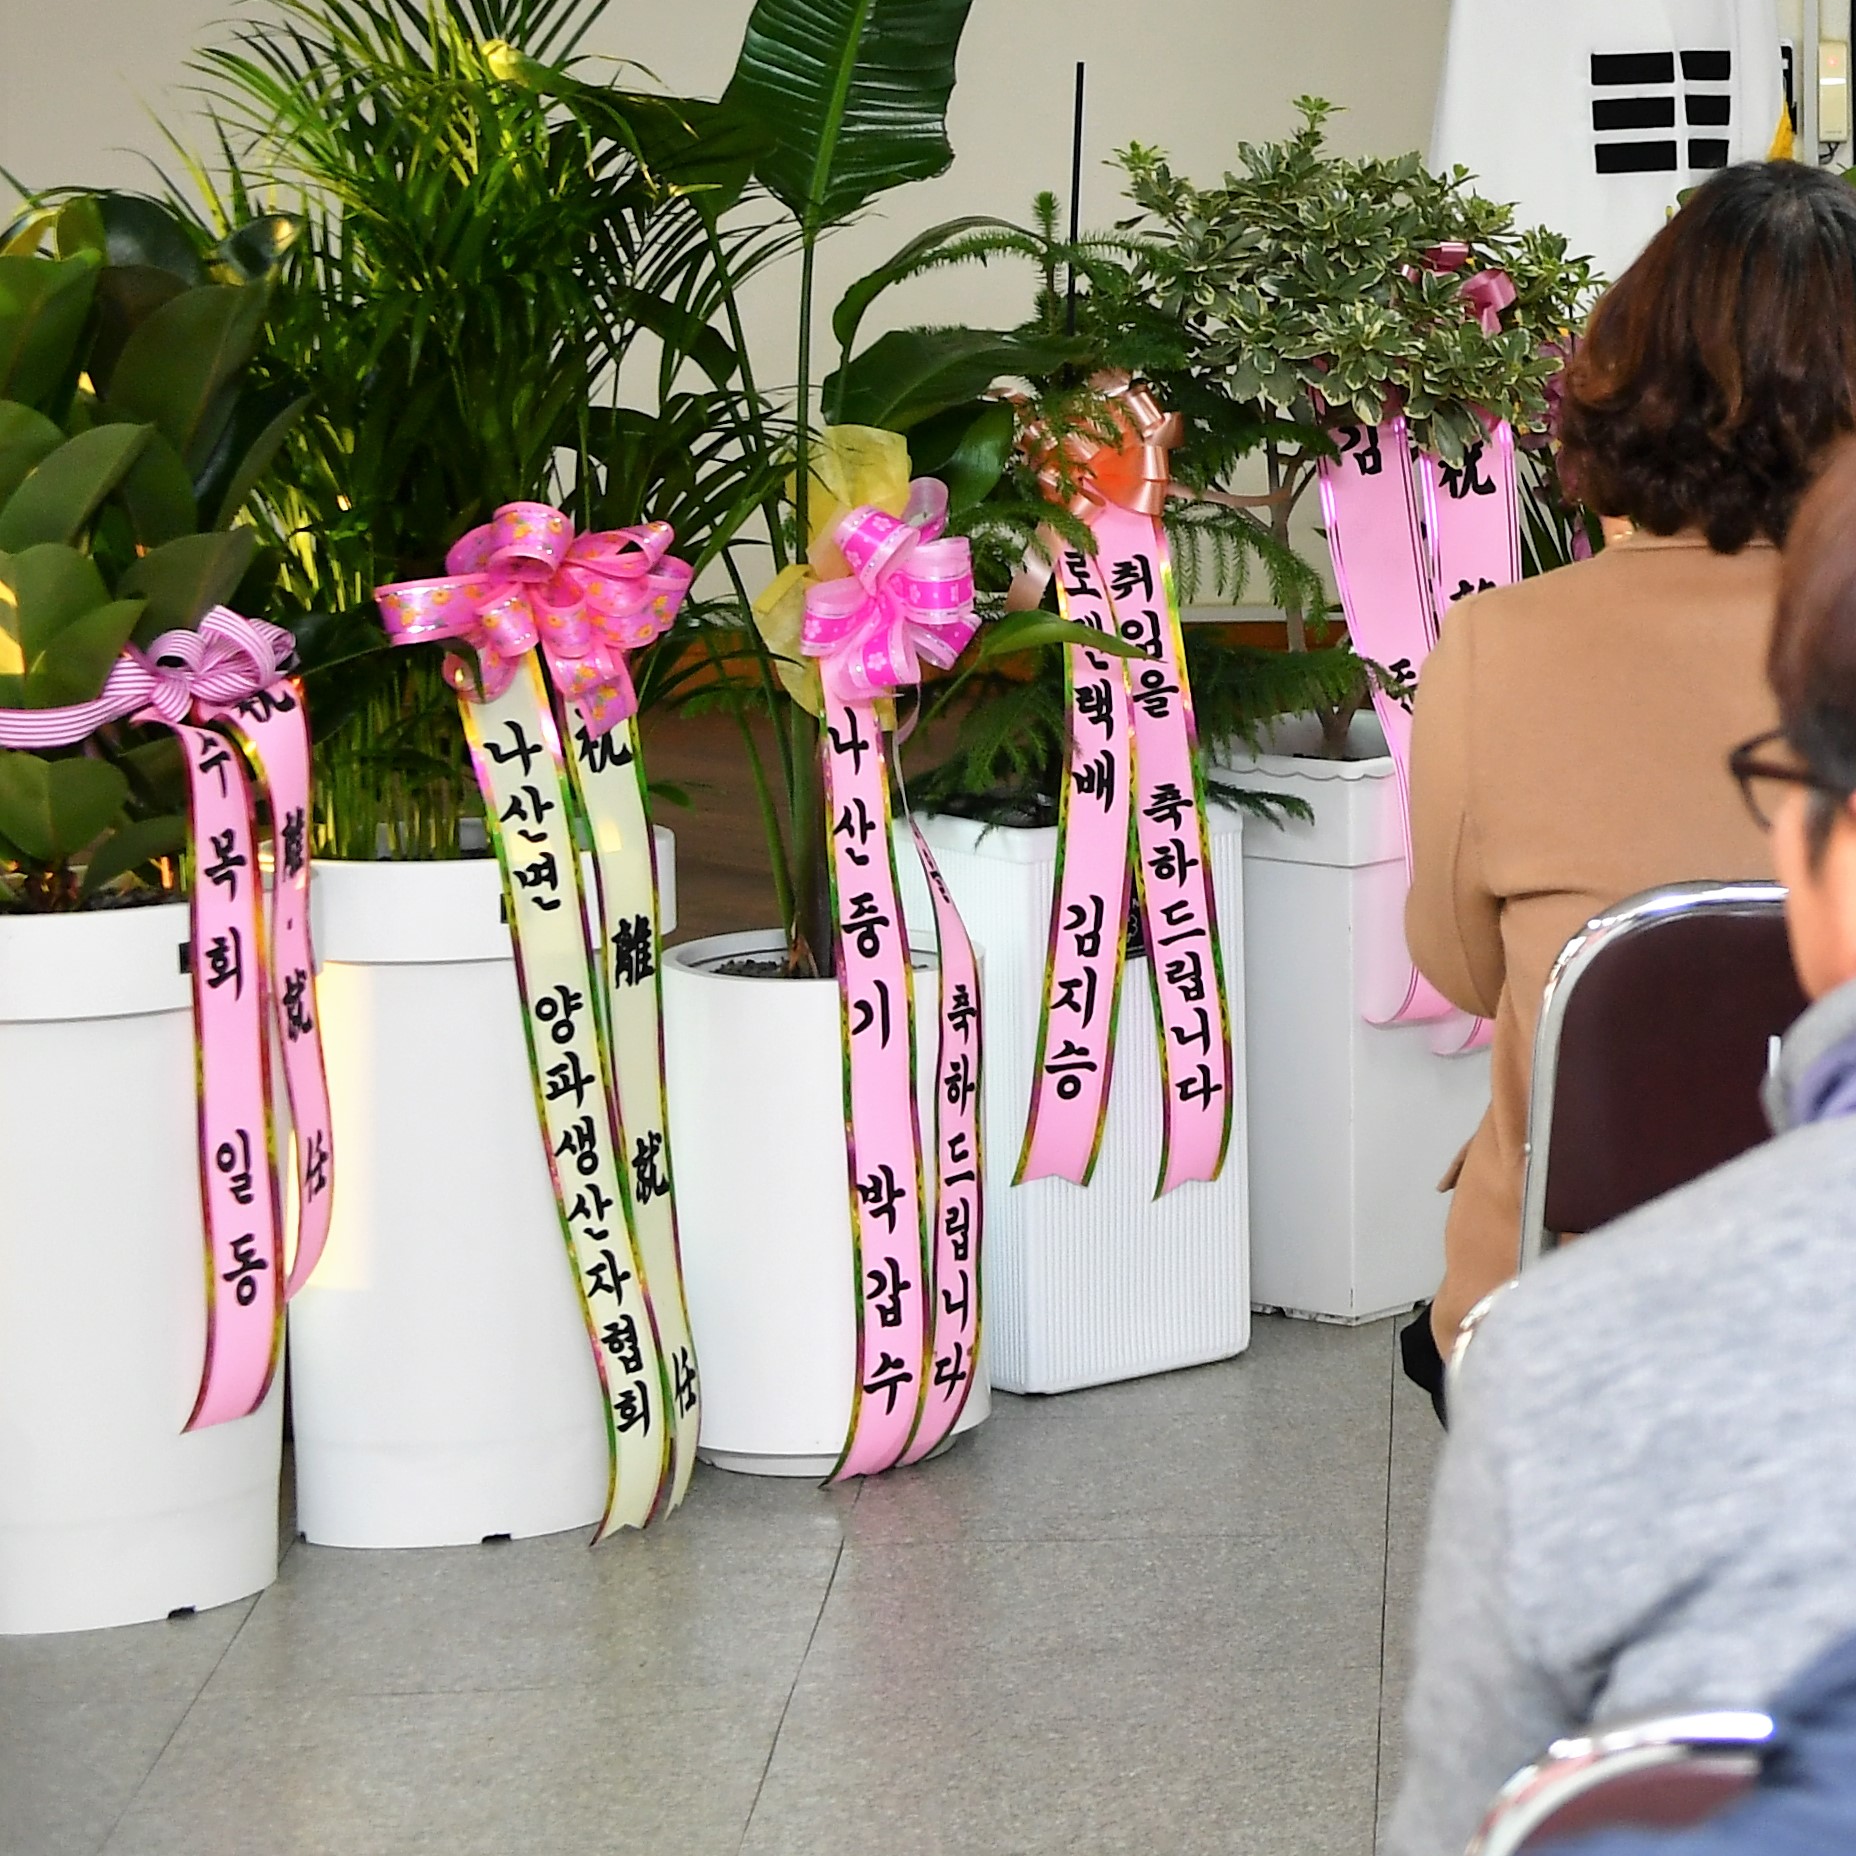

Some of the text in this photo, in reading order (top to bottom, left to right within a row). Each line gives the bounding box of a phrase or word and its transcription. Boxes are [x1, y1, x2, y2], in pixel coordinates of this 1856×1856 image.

[198, 731, 270, 1308] 수목회 일동
[483, 720, 651, 1437] 나산면 양파생산자협회
[825, 708, 913, 1416] 나산중기 박갑수
[1043, 896, 1110, 1101] 김지승
[1110, 553, 1225, 1110] 취임을 축하드립니다
[933, 984, 978, 1403] 축하드립니다
